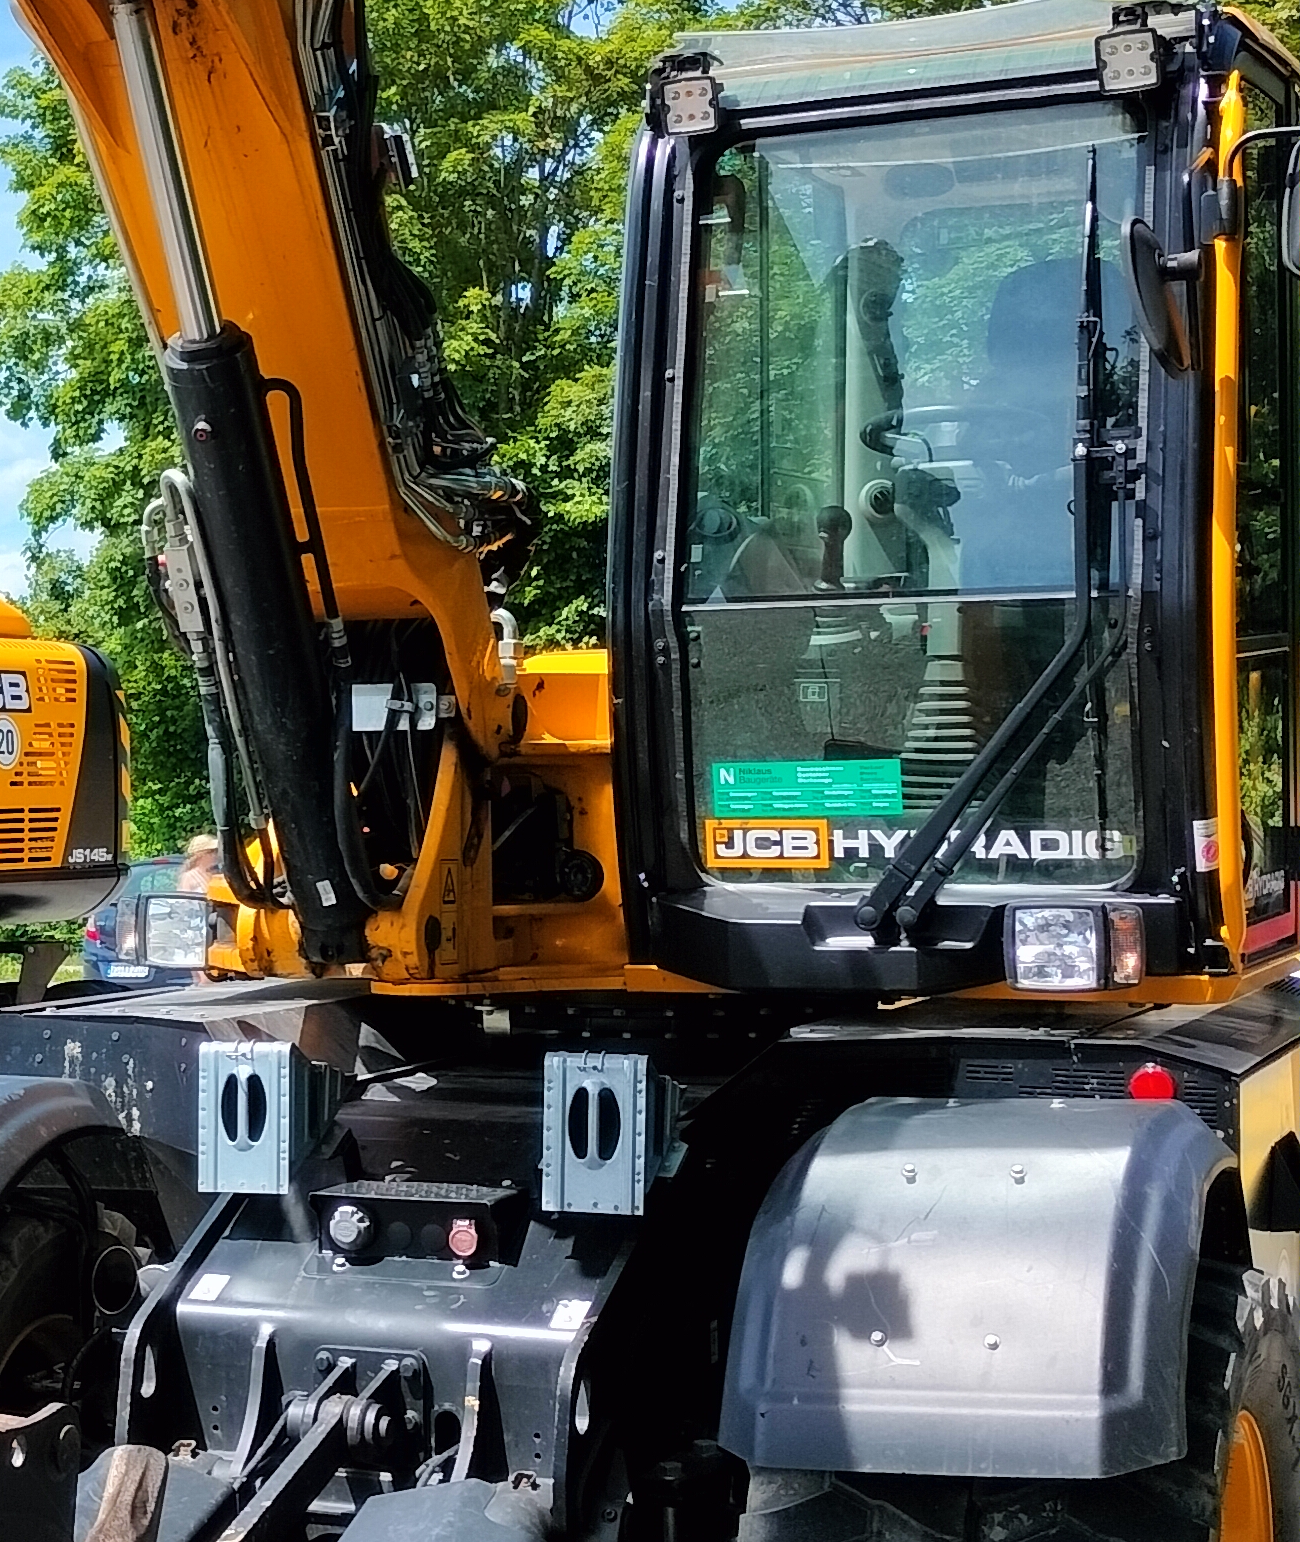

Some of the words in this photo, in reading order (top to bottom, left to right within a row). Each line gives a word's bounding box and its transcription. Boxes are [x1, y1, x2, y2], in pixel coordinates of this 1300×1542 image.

[719, 767, 735, 785] N
[738, 767, 772, 776] Niklaus
[716, 829, 818, 858] JCB
